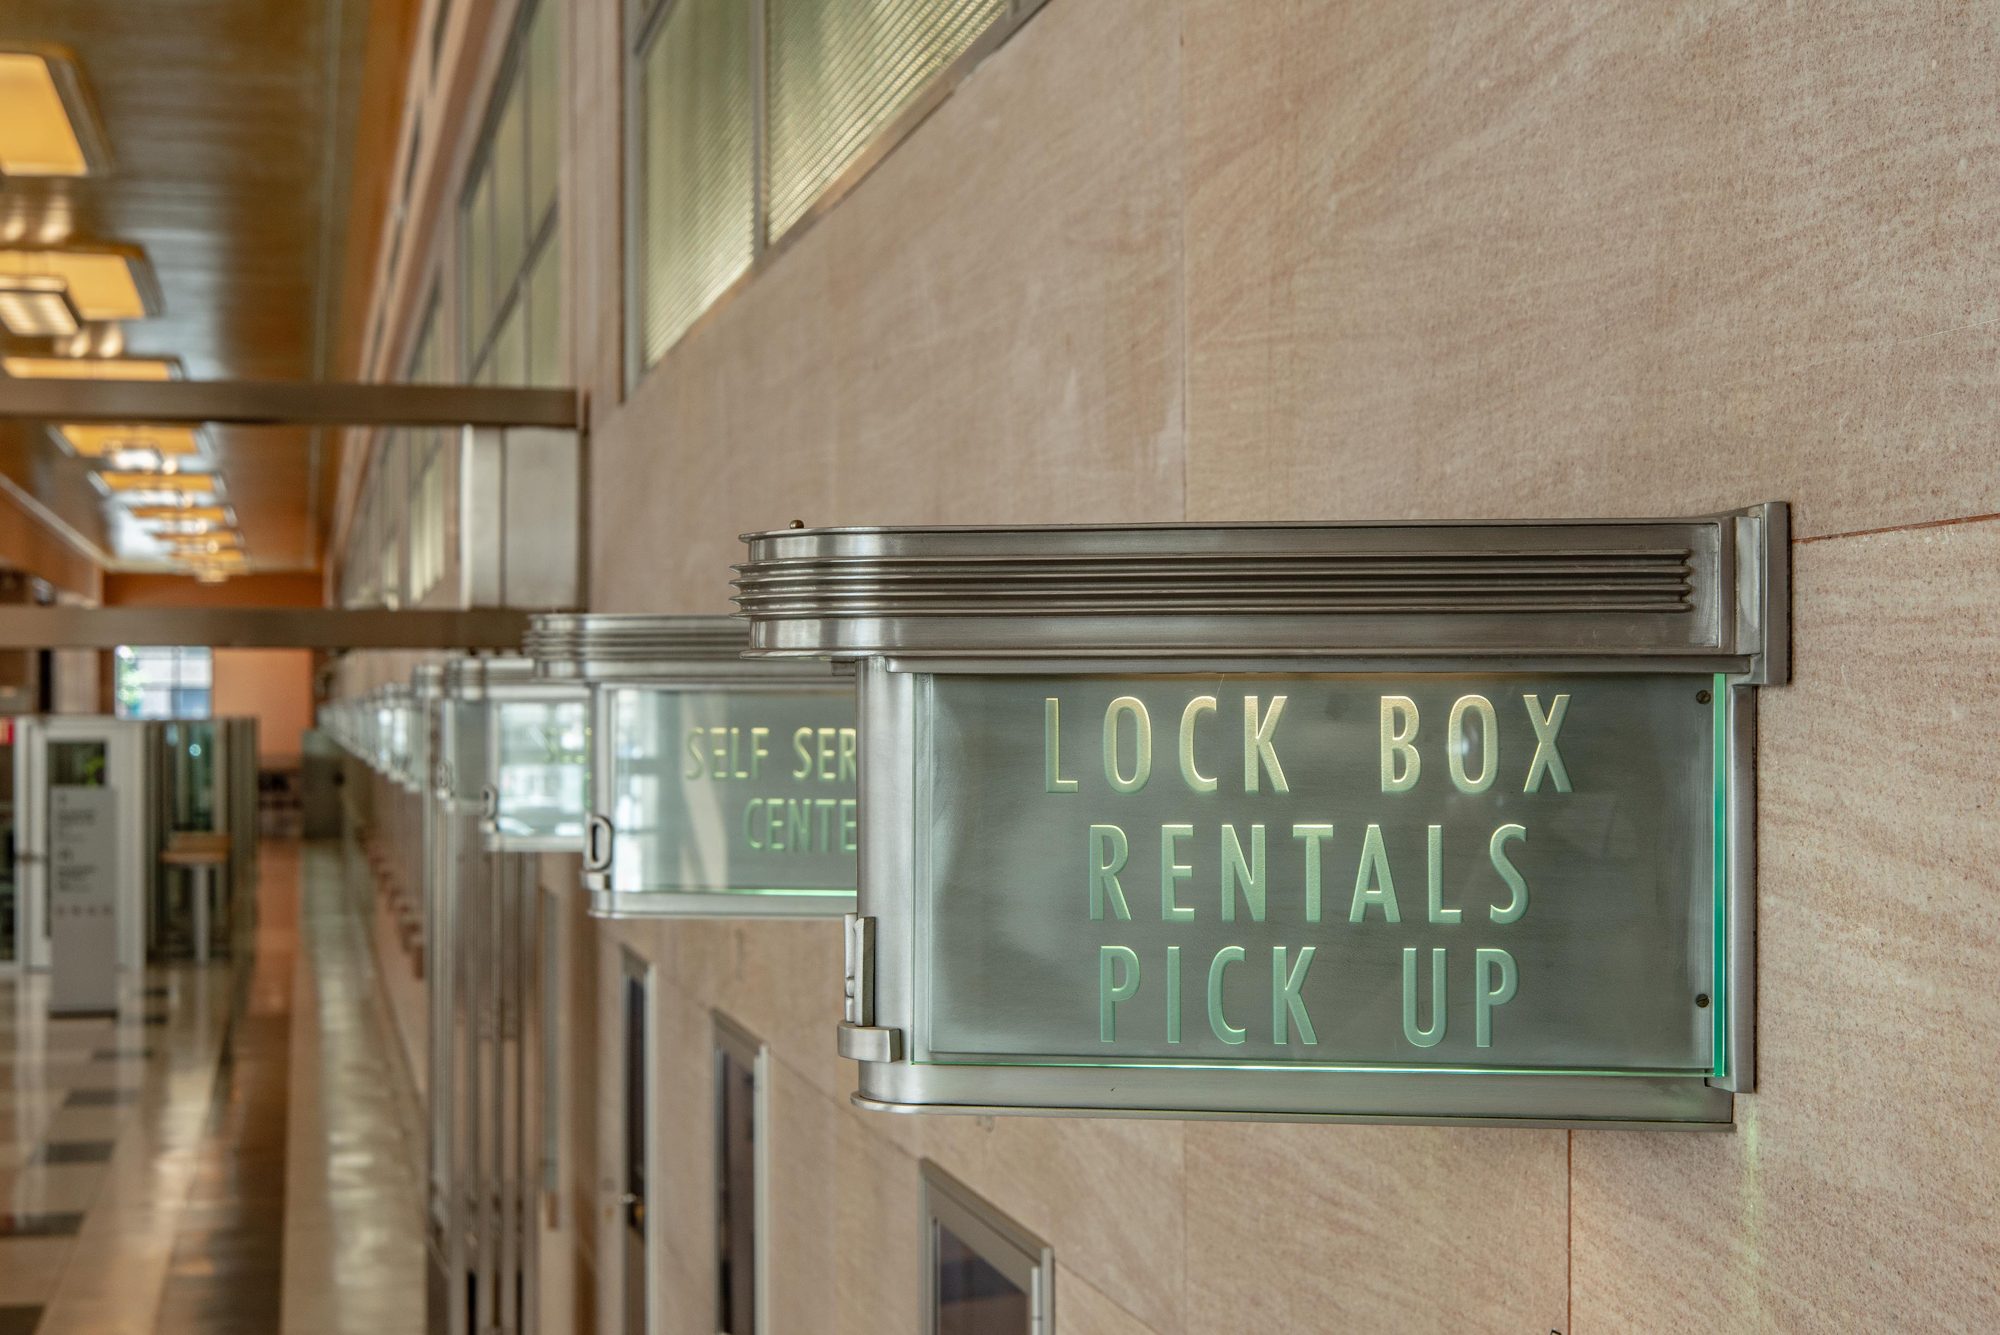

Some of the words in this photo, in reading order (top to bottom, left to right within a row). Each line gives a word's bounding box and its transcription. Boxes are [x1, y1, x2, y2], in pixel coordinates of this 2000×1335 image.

[686, 727, 769, 780] SELF
[1045, 695, 1290, 794] LOCK
[1380, 694, 1574, 794] BOX
[1089, 823, 1530, 924] RENTALS
[1100, 945, 1318, 1045] PICK
[1402, 947, 1519, 1048] UP
